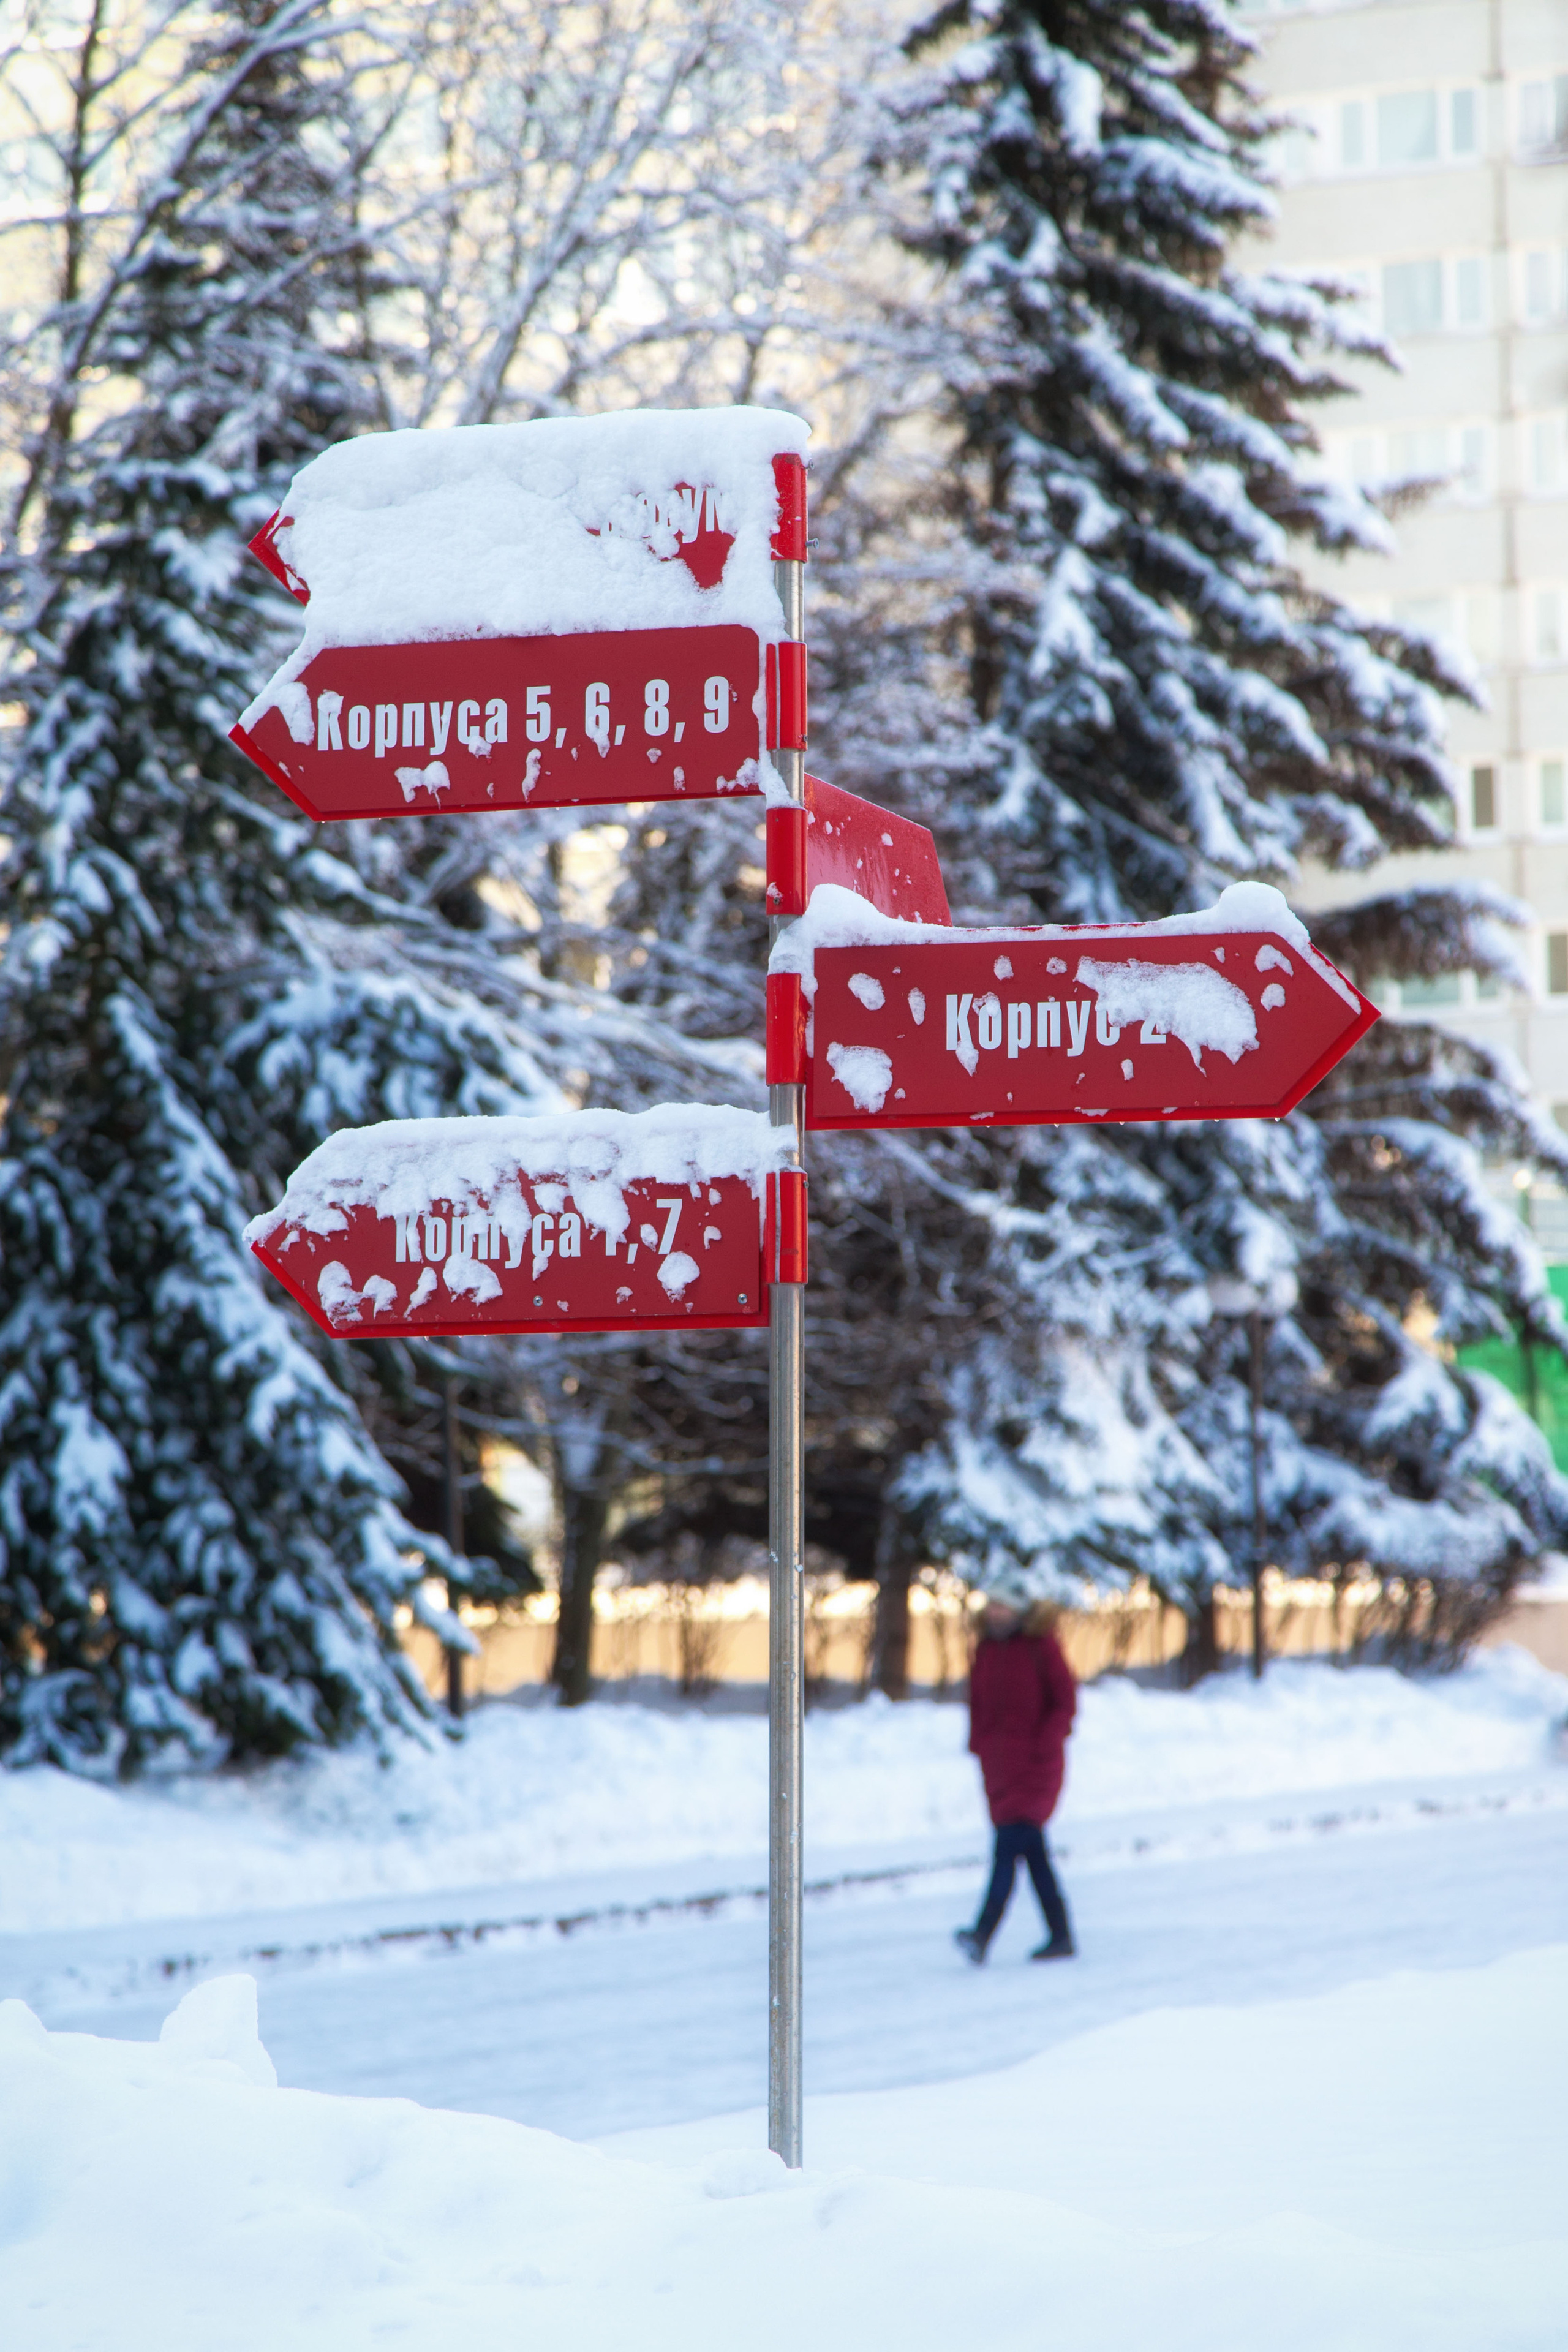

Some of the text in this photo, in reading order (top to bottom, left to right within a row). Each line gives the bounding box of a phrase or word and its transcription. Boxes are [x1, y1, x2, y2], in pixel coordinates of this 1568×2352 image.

[317, 676, 729, 758] Корпуса 5, 6, 8, 9
[946, 993, 1121, 1059] Корпус
[655, 1198, 683, 1255] 7
